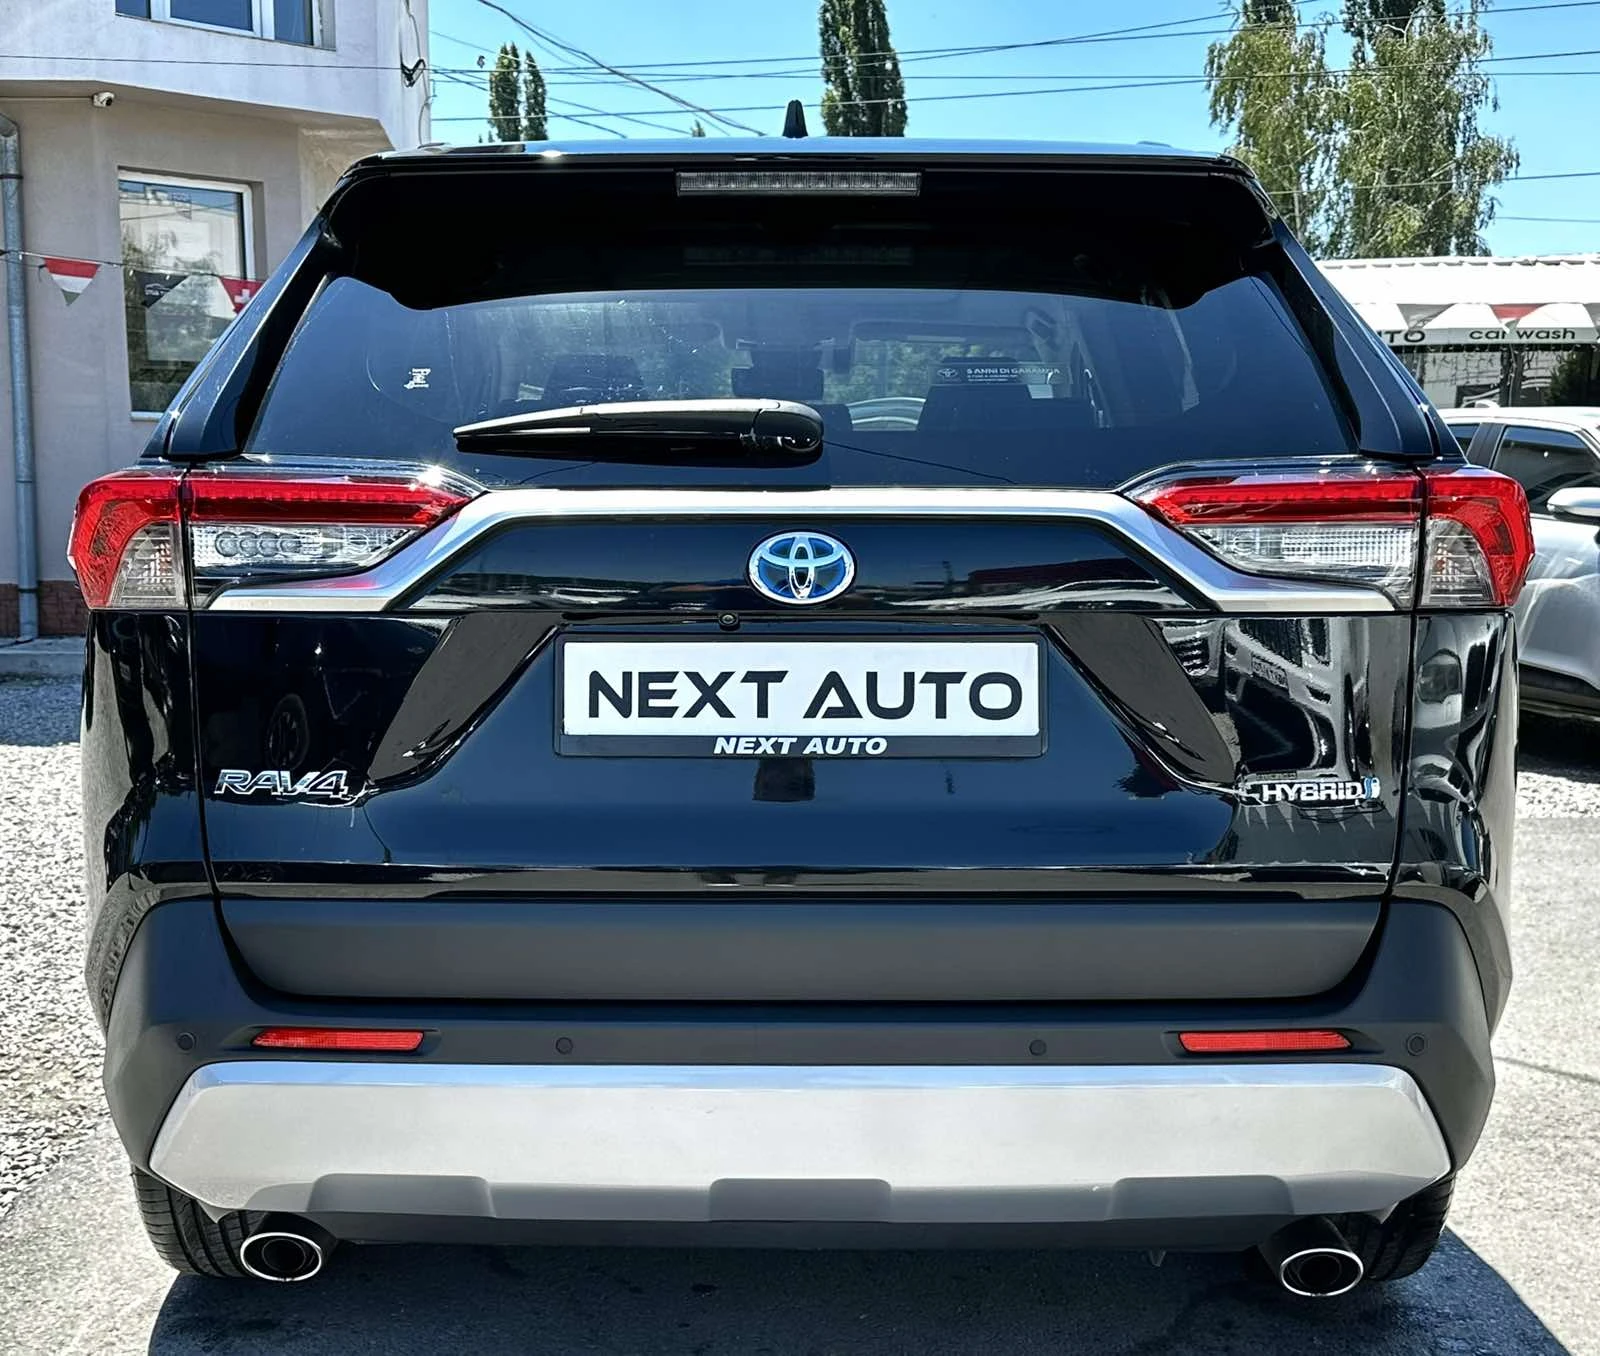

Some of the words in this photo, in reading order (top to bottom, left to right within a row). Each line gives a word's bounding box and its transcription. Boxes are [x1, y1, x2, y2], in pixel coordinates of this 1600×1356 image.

[1377, 330, 1426, 343] TO
[1516, 328, 1576, 340] wash
[588, 670, 788, 719] NEXT
[803, 670, 1023, 720] AUTO
[713, 737, 798, 755] NEXT
[802, 737, 888, 755] AUTO
[214, 769, 349, 798] RAV4
[1262, 783, 1364, 802] HYBRID
